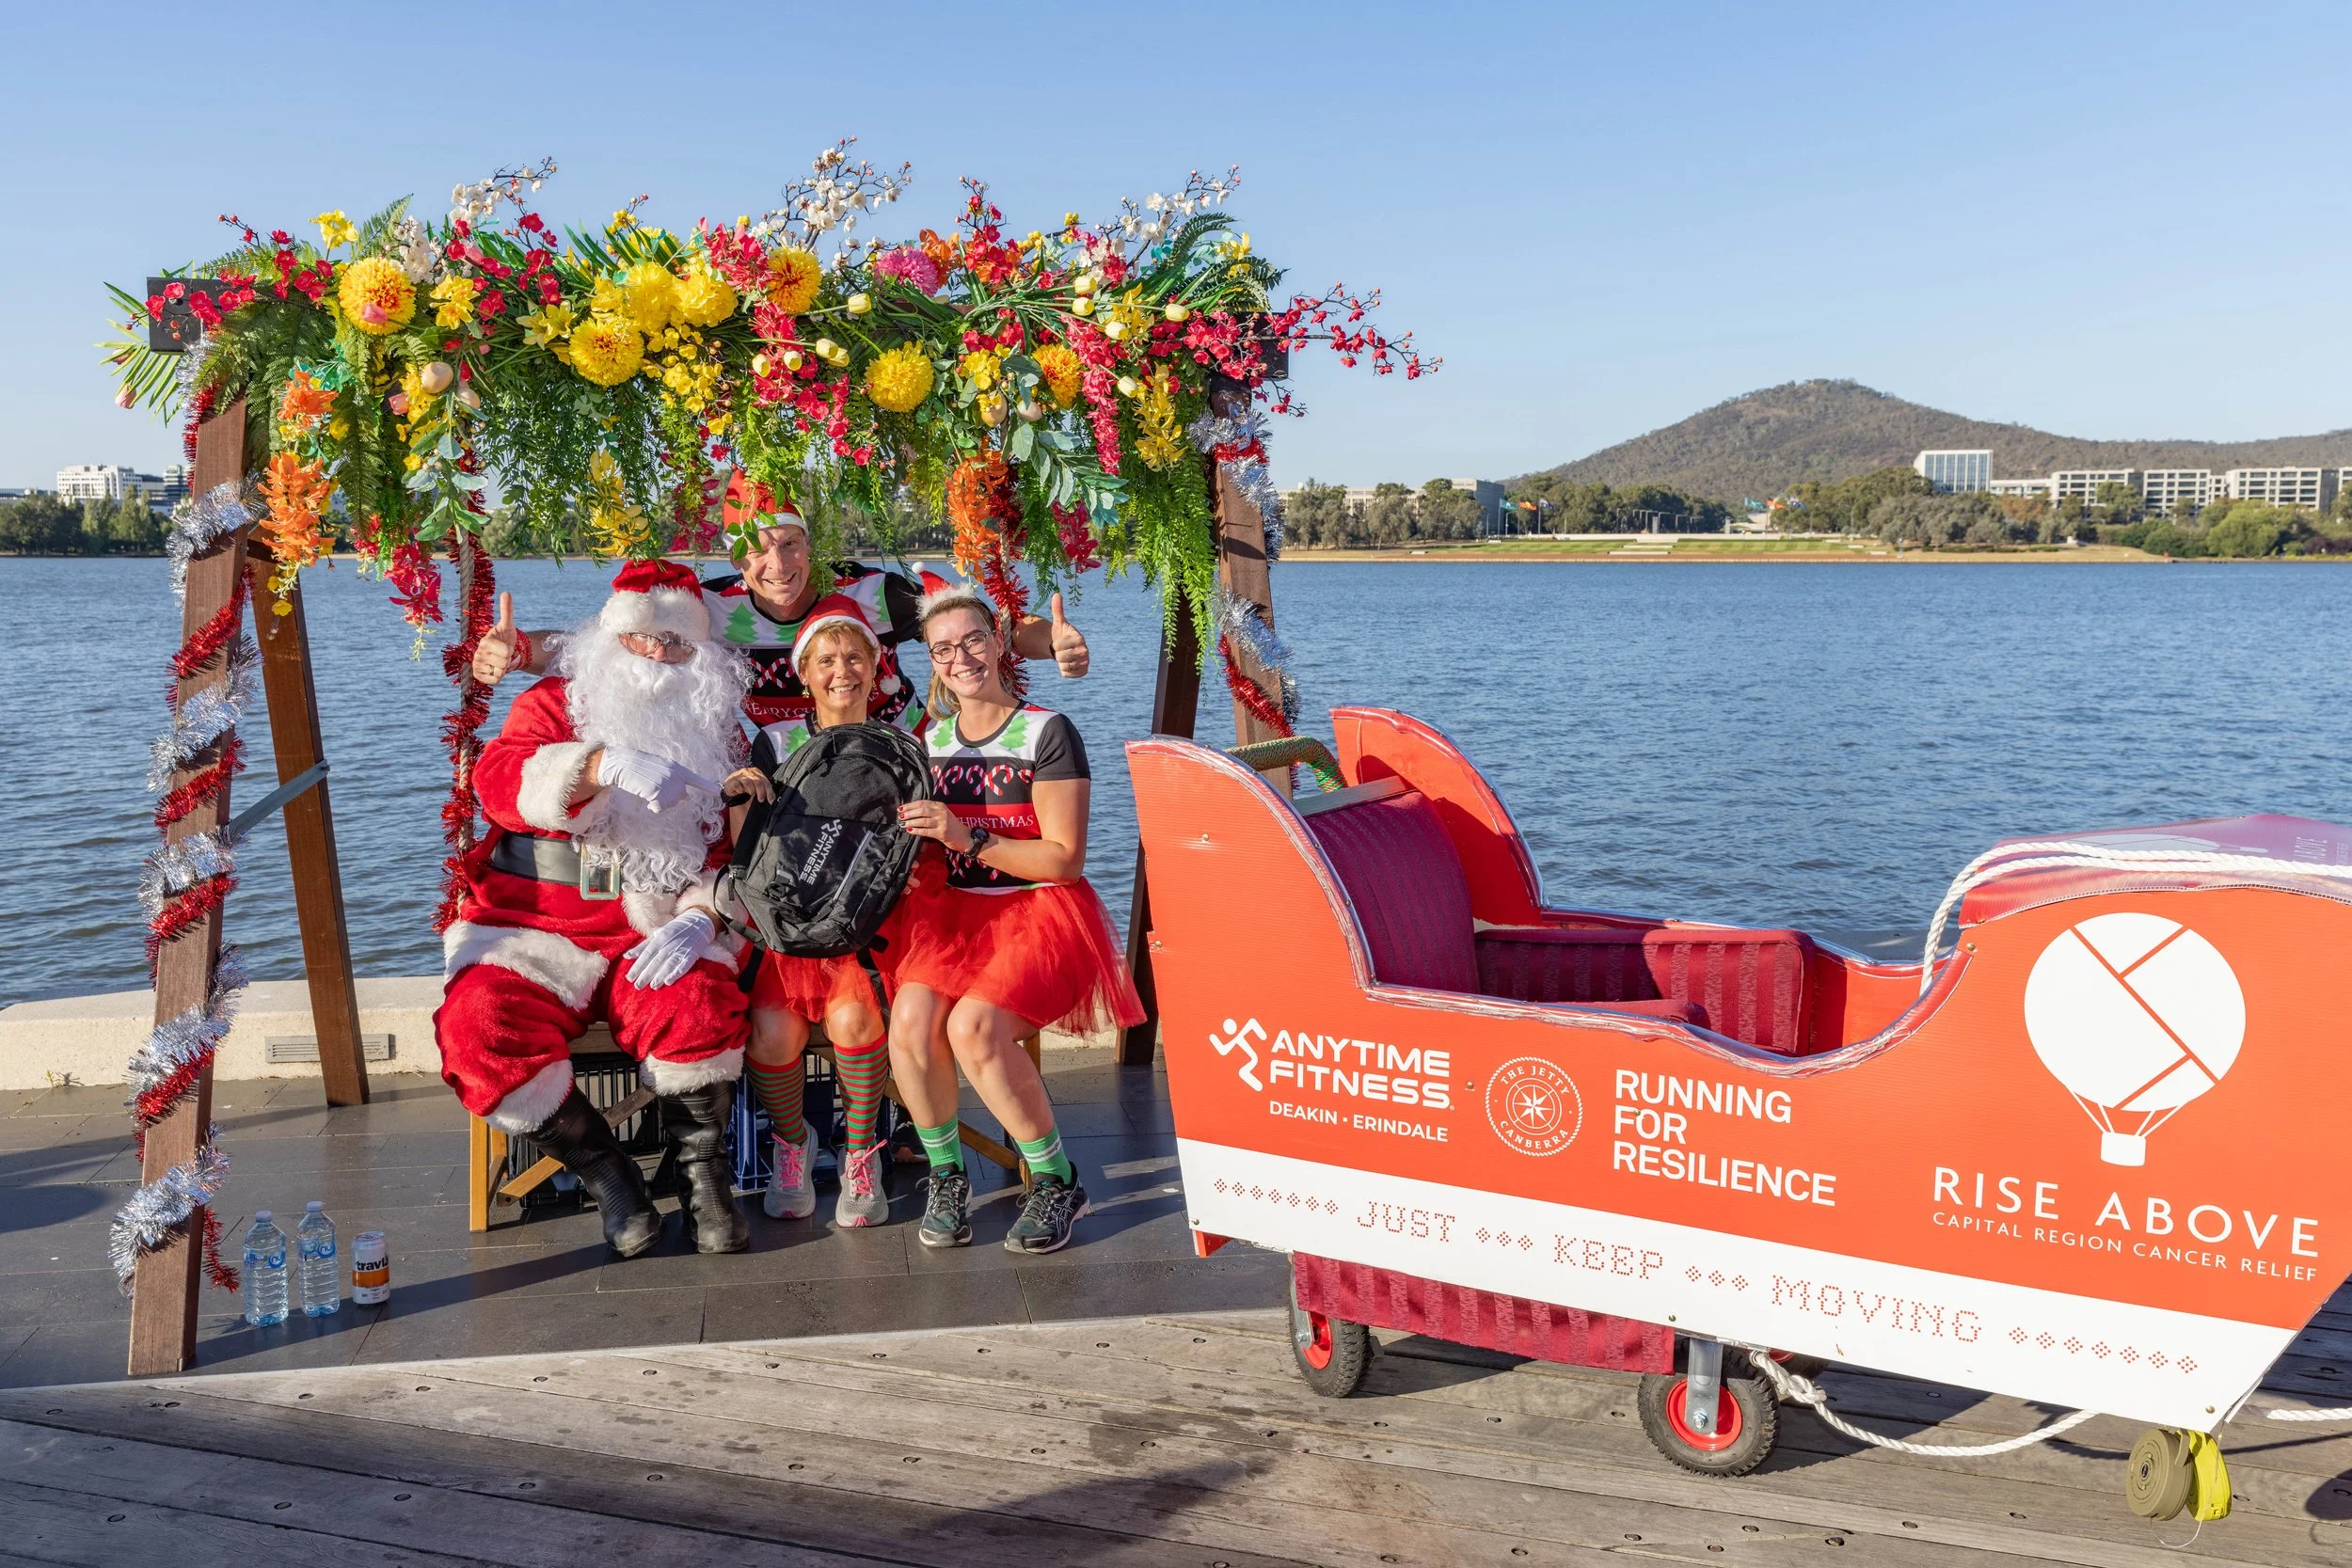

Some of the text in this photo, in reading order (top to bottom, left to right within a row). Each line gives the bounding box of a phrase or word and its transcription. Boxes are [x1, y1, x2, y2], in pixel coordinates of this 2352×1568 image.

[958, 815, 1034, 829] HRISTMAS
[800, 832, 828, 881] FITNESS
[806, 835, 834, 885] ANYTIME
[1270, 1029, 1451, 1078] ANYTIME
[1269, 1059, 1451, 1110] FITNESS
[1500, 1065, 1570, 1095] THE JETTY
[1615, 1069, 1792, 1124] RUNNING
[1269, 1100, 1449, 1143] DEAKIN ERINDALE
[1500, 1120, 1569, 1149] CANBERRA
[1614, 1104, 1688, 1145] FOR
[1613, 1140, 1836, 1207] RESILIENCE
[1933, 1165, 2319, 1258] RISE ABOVE
[1357, 1200, 1981, 1343] JUST KEEP MOVING
[1932, 1212, 2318, 1283] CAPITAL REGION CANCER RELIEF
